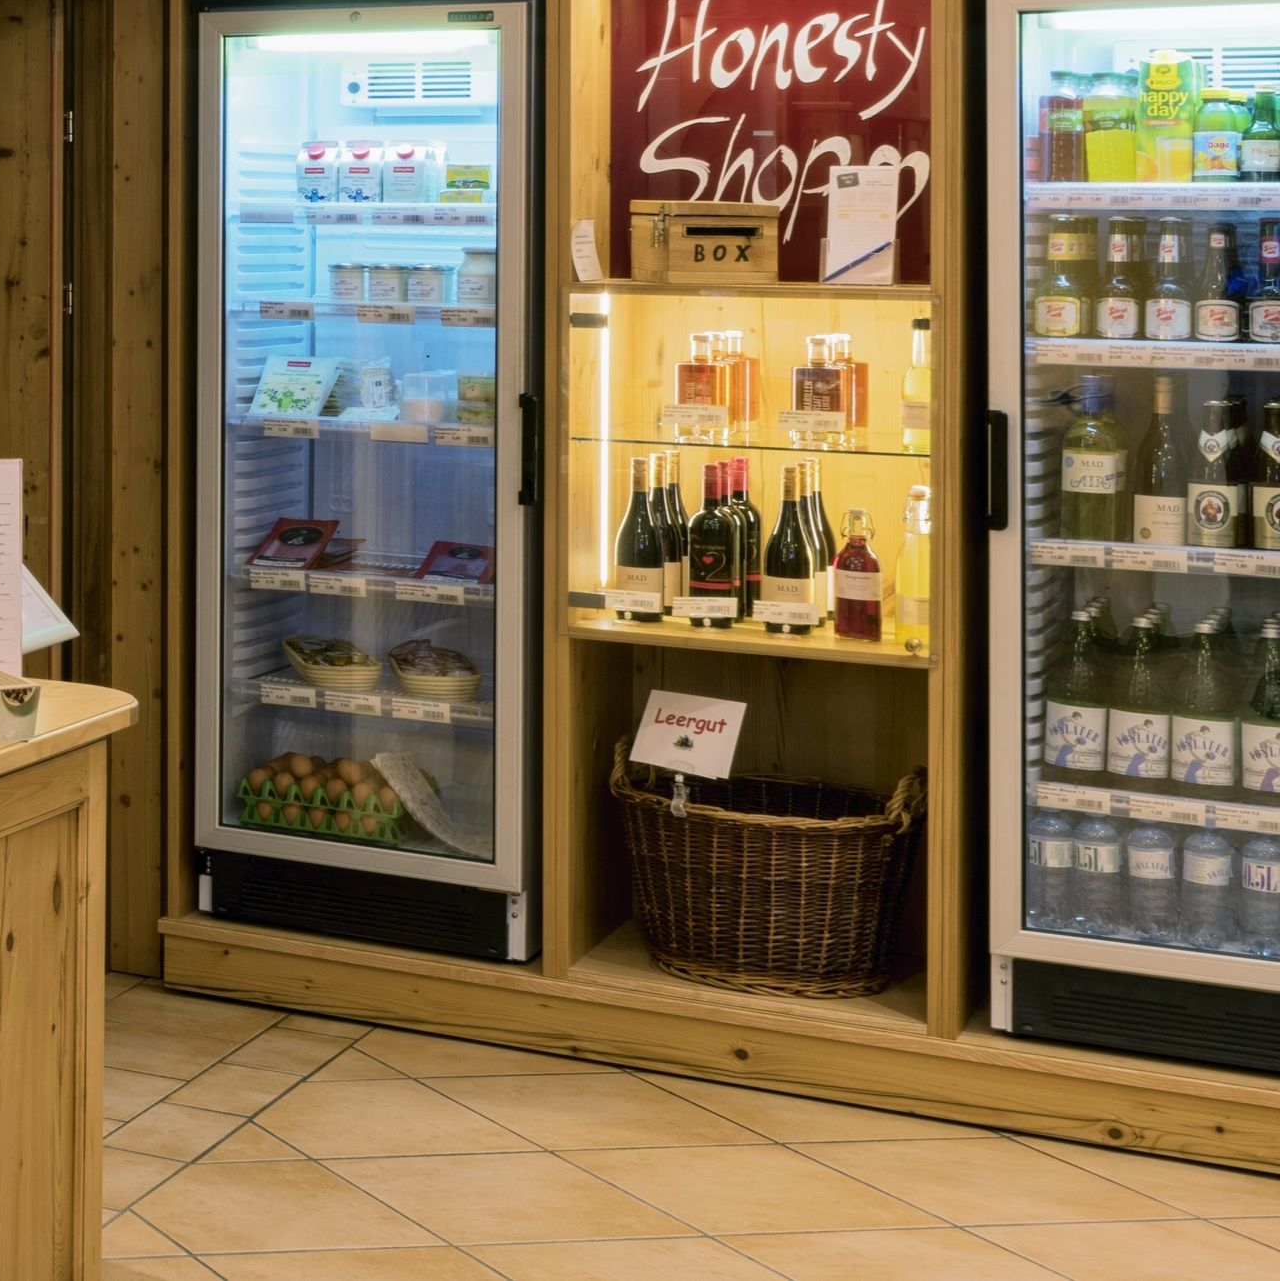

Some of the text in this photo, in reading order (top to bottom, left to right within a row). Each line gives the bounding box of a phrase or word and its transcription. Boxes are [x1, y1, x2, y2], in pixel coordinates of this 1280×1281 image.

[1138, 90, 1189, 108] happy
[1146, 103, 1180, 120] day
[640, 114, 852, 246] Shop
[694, 243, 753, 263] BOX
[1080, 459, 1104, 469] MAD
[1156, 503, 1180, 512] MAD
[627, 573, 648, 582] MAD
[776, 583, 798, 593] MAD
[654, 707, 728, 735] Leergut
